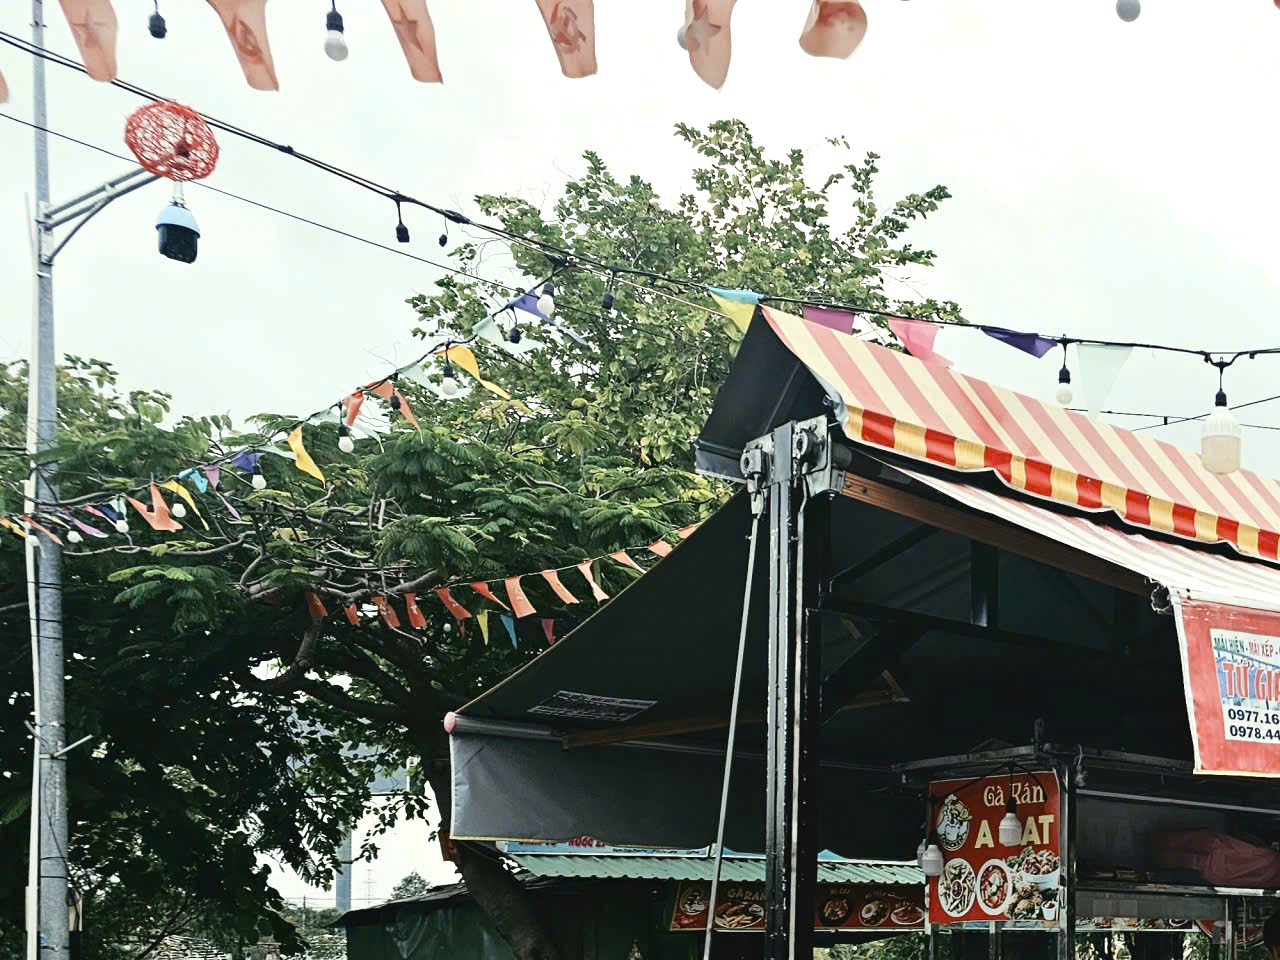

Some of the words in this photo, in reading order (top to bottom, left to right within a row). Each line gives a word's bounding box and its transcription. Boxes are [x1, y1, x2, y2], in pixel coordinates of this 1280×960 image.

[983, 785, 1005, 807] Gà
[1010, 782, 1045, 805] Rán
[974, 820, 995, 849] A
